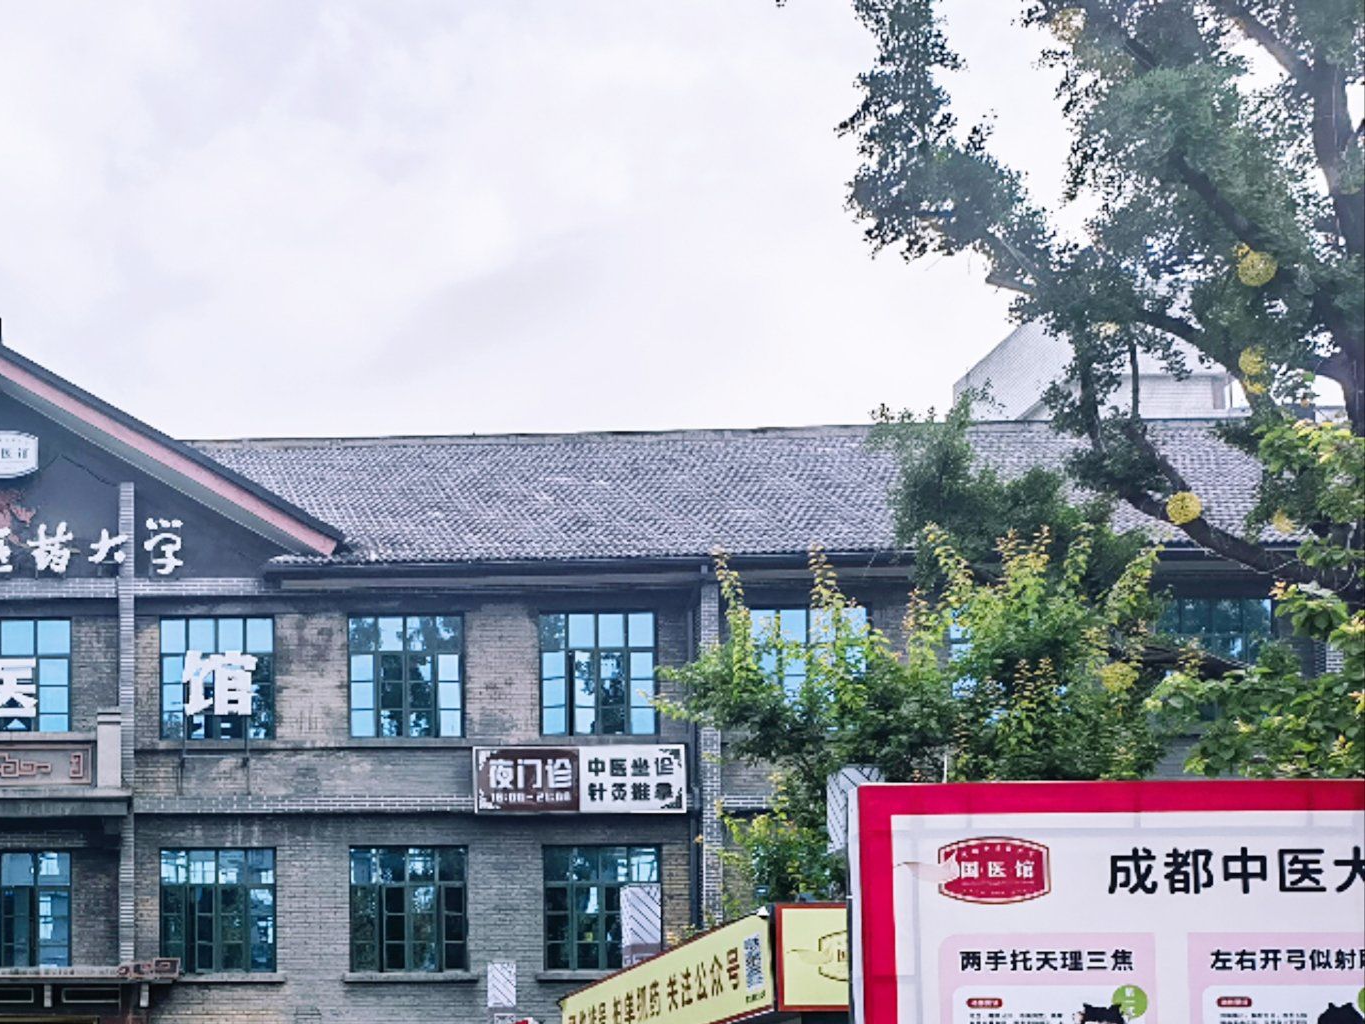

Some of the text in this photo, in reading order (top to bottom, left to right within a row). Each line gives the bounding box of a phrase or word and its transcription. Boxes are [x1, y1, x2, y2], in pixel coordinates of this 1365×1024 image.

[489, 758, 573, 789] 夜门诊
[588, 757, 674, 777] 中医坐诊
[588, 782, 674, 802] 针灸推拿
[960, 859, 1035, 879] 国医馆
[1108, 845, 1365, 894] 成都中医大
[959, 949, 1134, 972] 两手托天理三焦
[1210, 949, 1365, 971] 左右开弓似射
[666, 947, 740, 1012] 关注公众号
